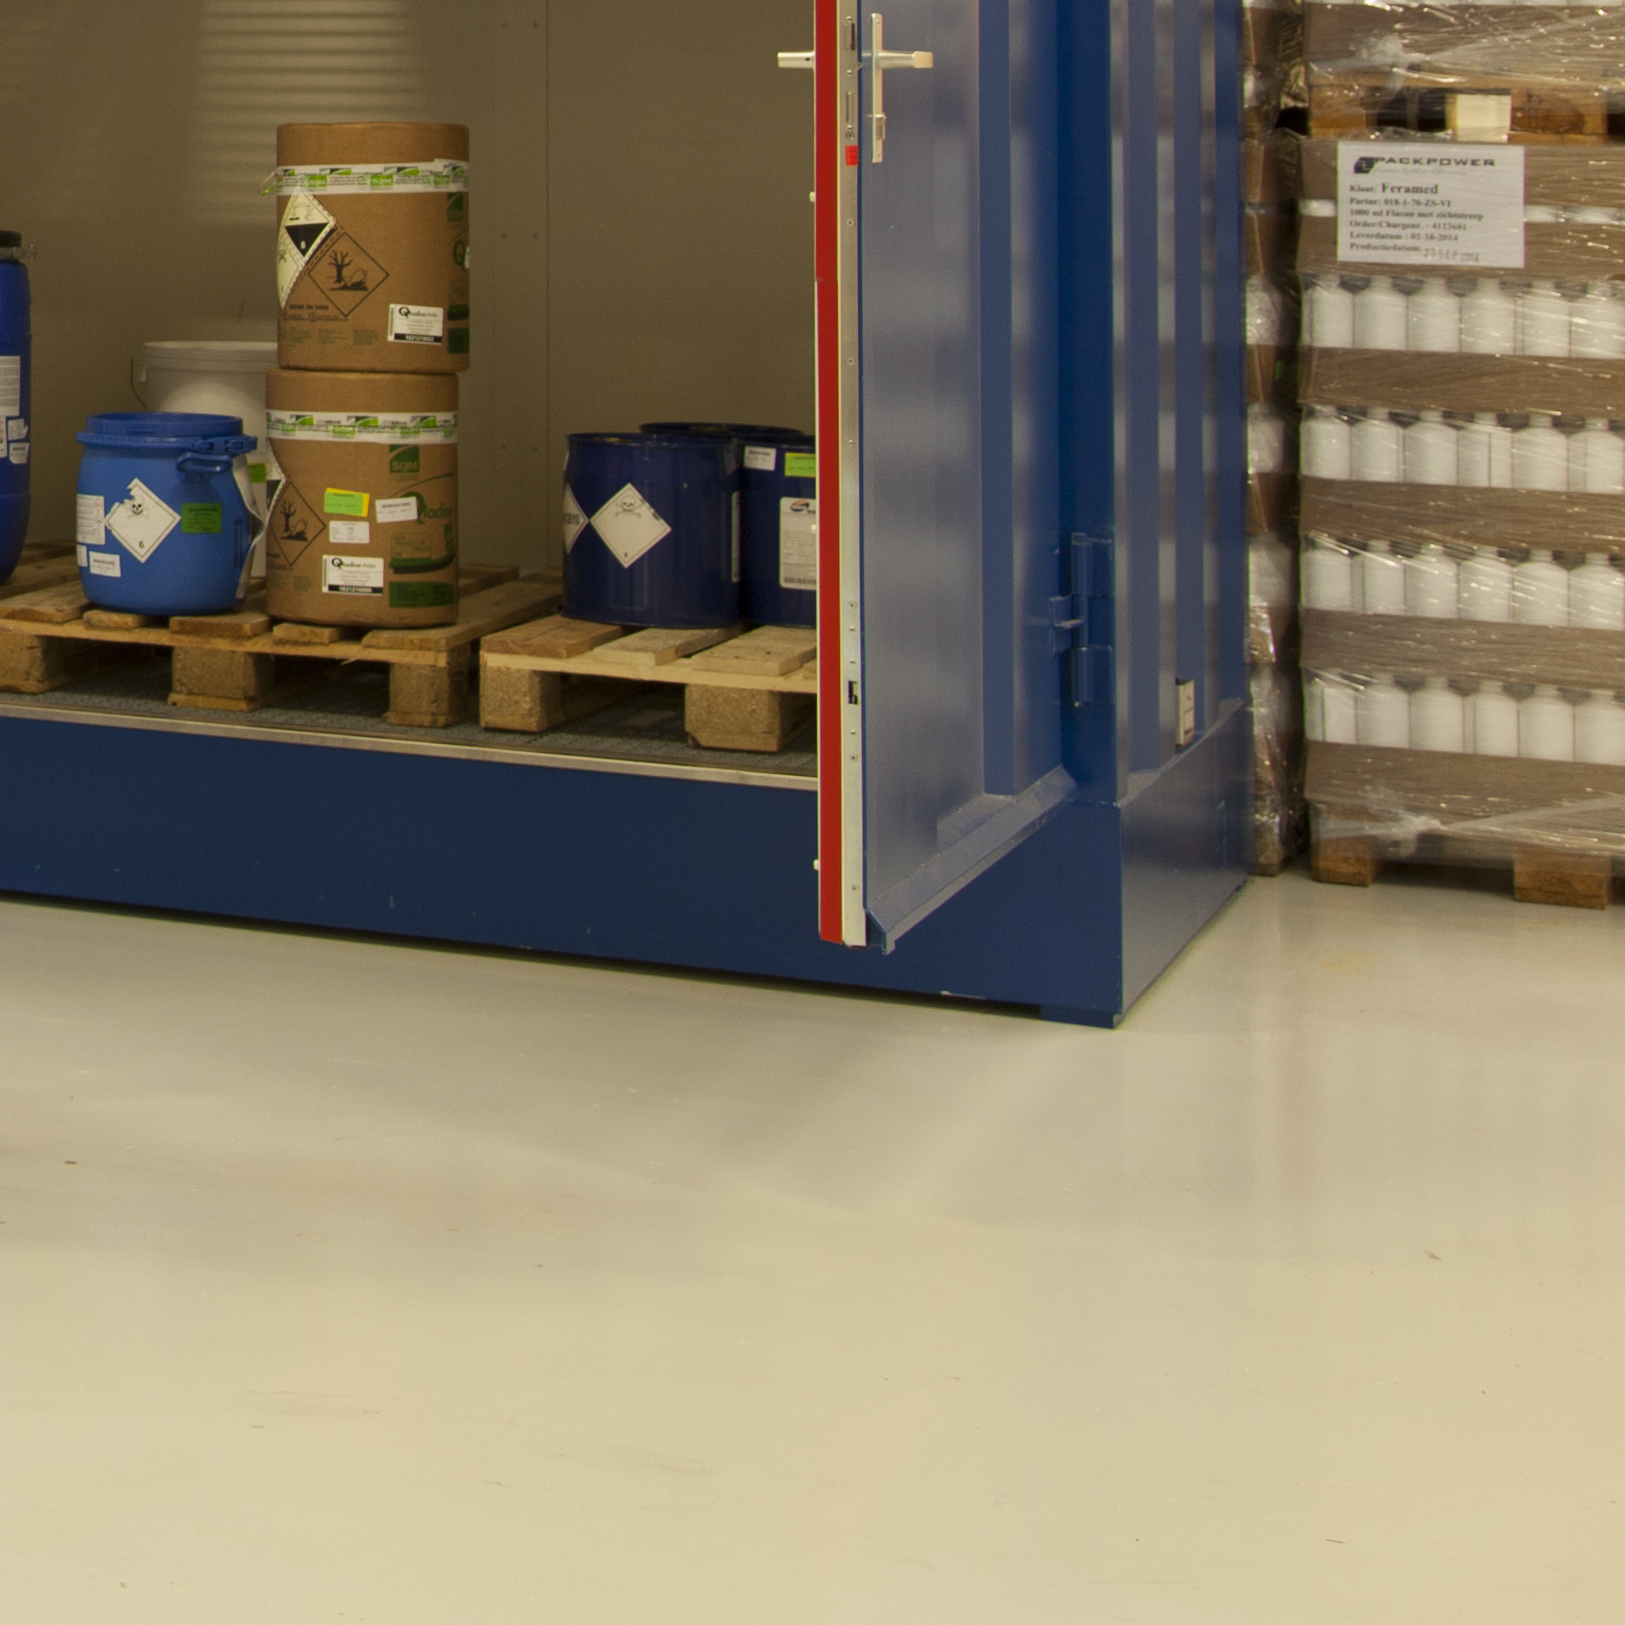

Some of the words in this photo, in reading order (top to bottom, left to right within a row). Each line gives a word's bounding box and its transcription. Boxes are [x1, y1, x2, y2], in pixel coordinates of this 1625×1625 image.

[1375, 156, 1496, 167] PACKPOWER
[1381, 182, 1439, 194] Feramed
[392, 461, 418, 472] SQM
[138, 540, 145, 549] 6
